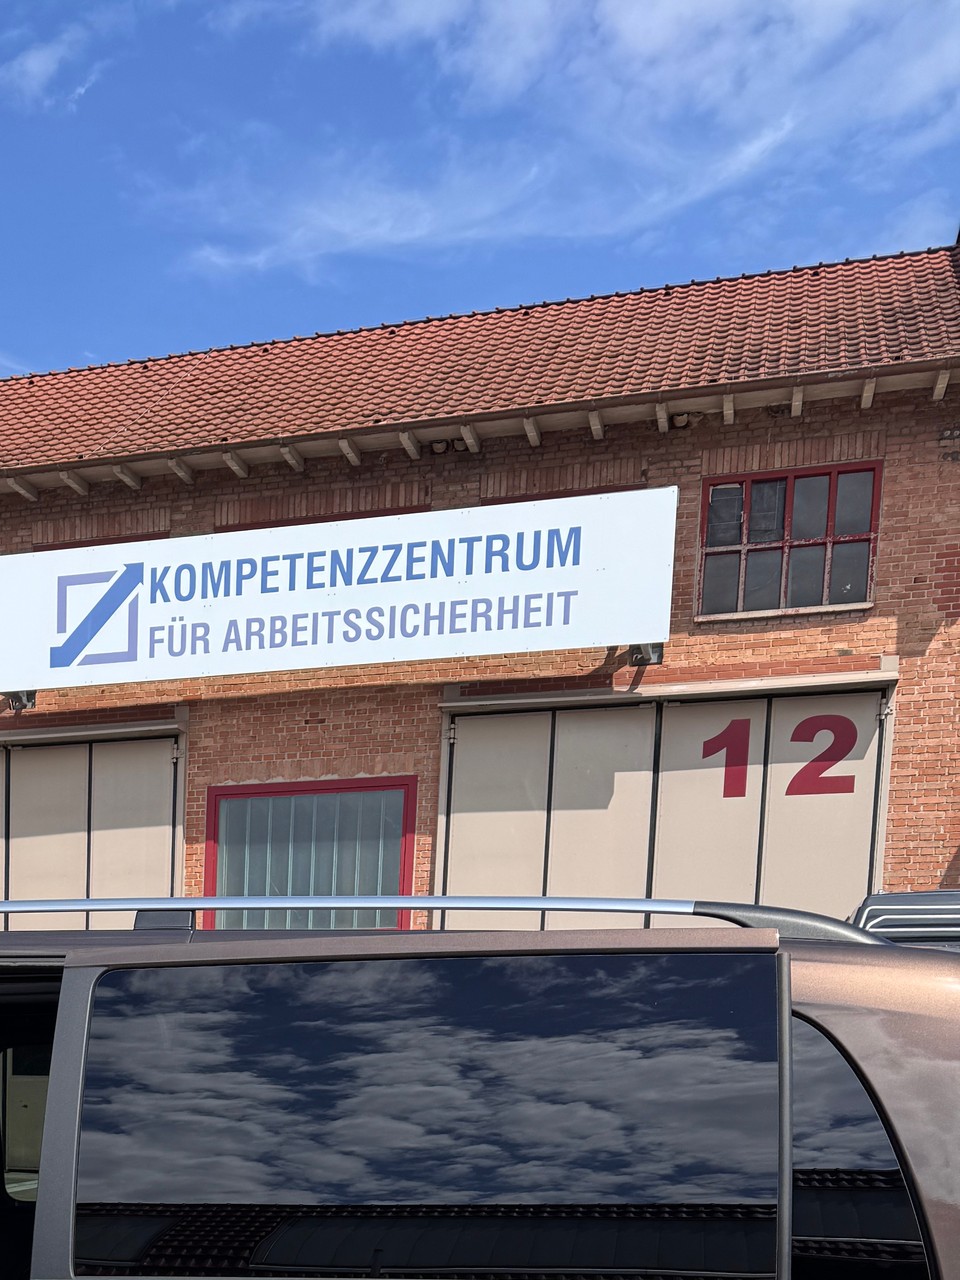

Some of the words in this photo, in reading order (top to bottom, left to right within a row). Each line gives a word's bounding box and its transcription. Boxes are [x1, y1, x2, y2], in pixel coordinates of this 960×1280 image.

[149, 526, 582, 605] KOMPETENZZENTRUM
[148, 621, 210, 659] FÜR
[222, 590, 578, 654] ARBEITSSICHERHEIT
[702, 714, 858, 799] 12
